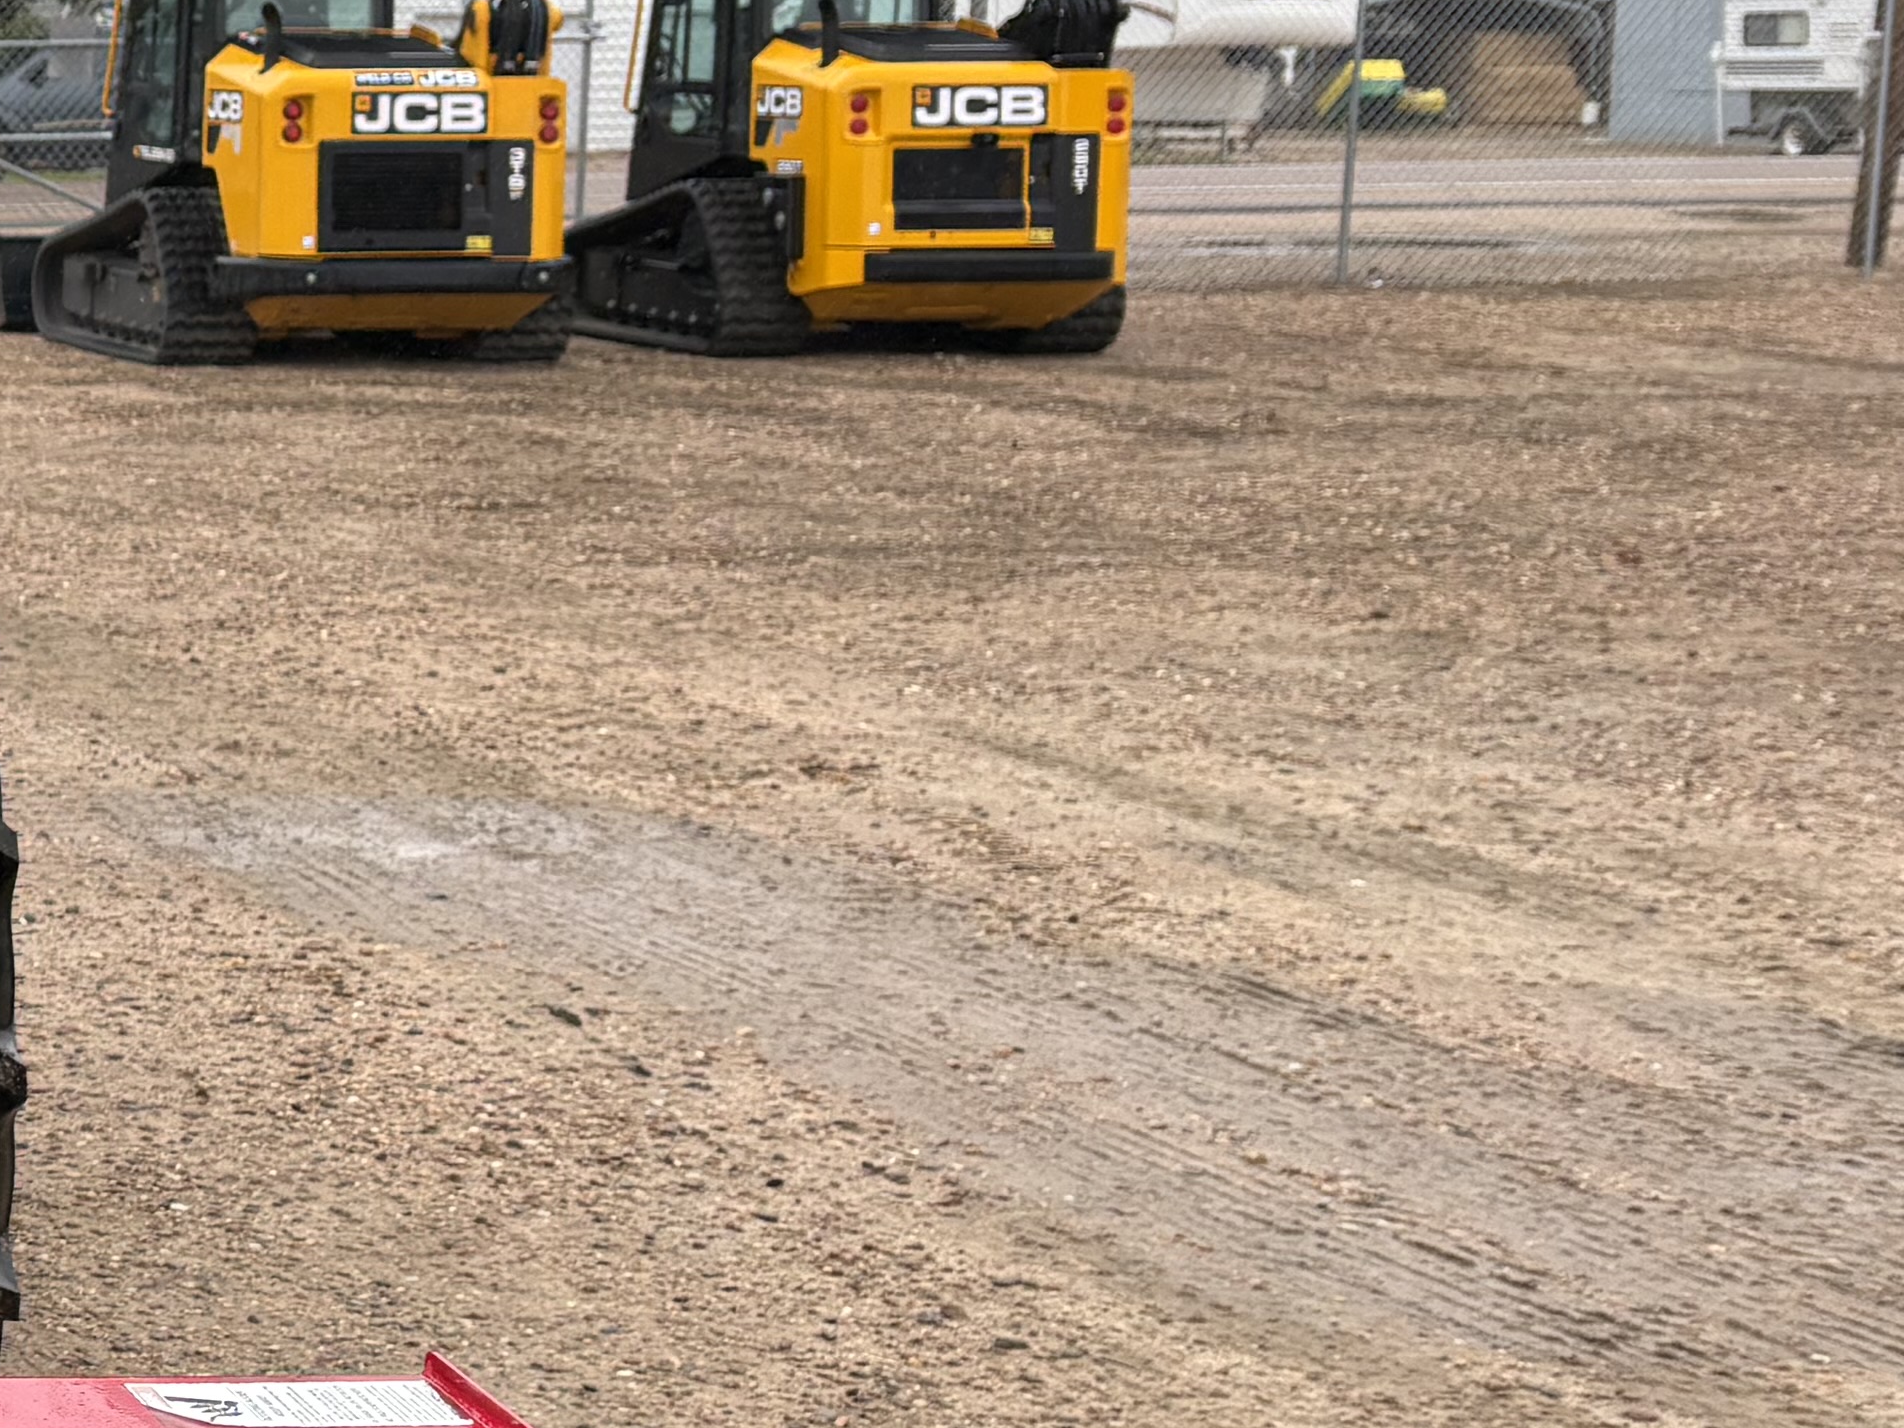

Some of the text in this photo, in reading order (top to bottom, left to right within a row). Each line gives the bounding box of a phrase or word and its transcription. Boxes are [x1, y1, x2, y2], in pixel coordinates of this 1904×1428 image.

[419, 71, 477, 86] JCB
[208, 90, 243, 121] JCB
[354, 93, 485, 133] JCB
[757, 85, 802, 117] JCB
[915, 86, 1046, 126] JCB
